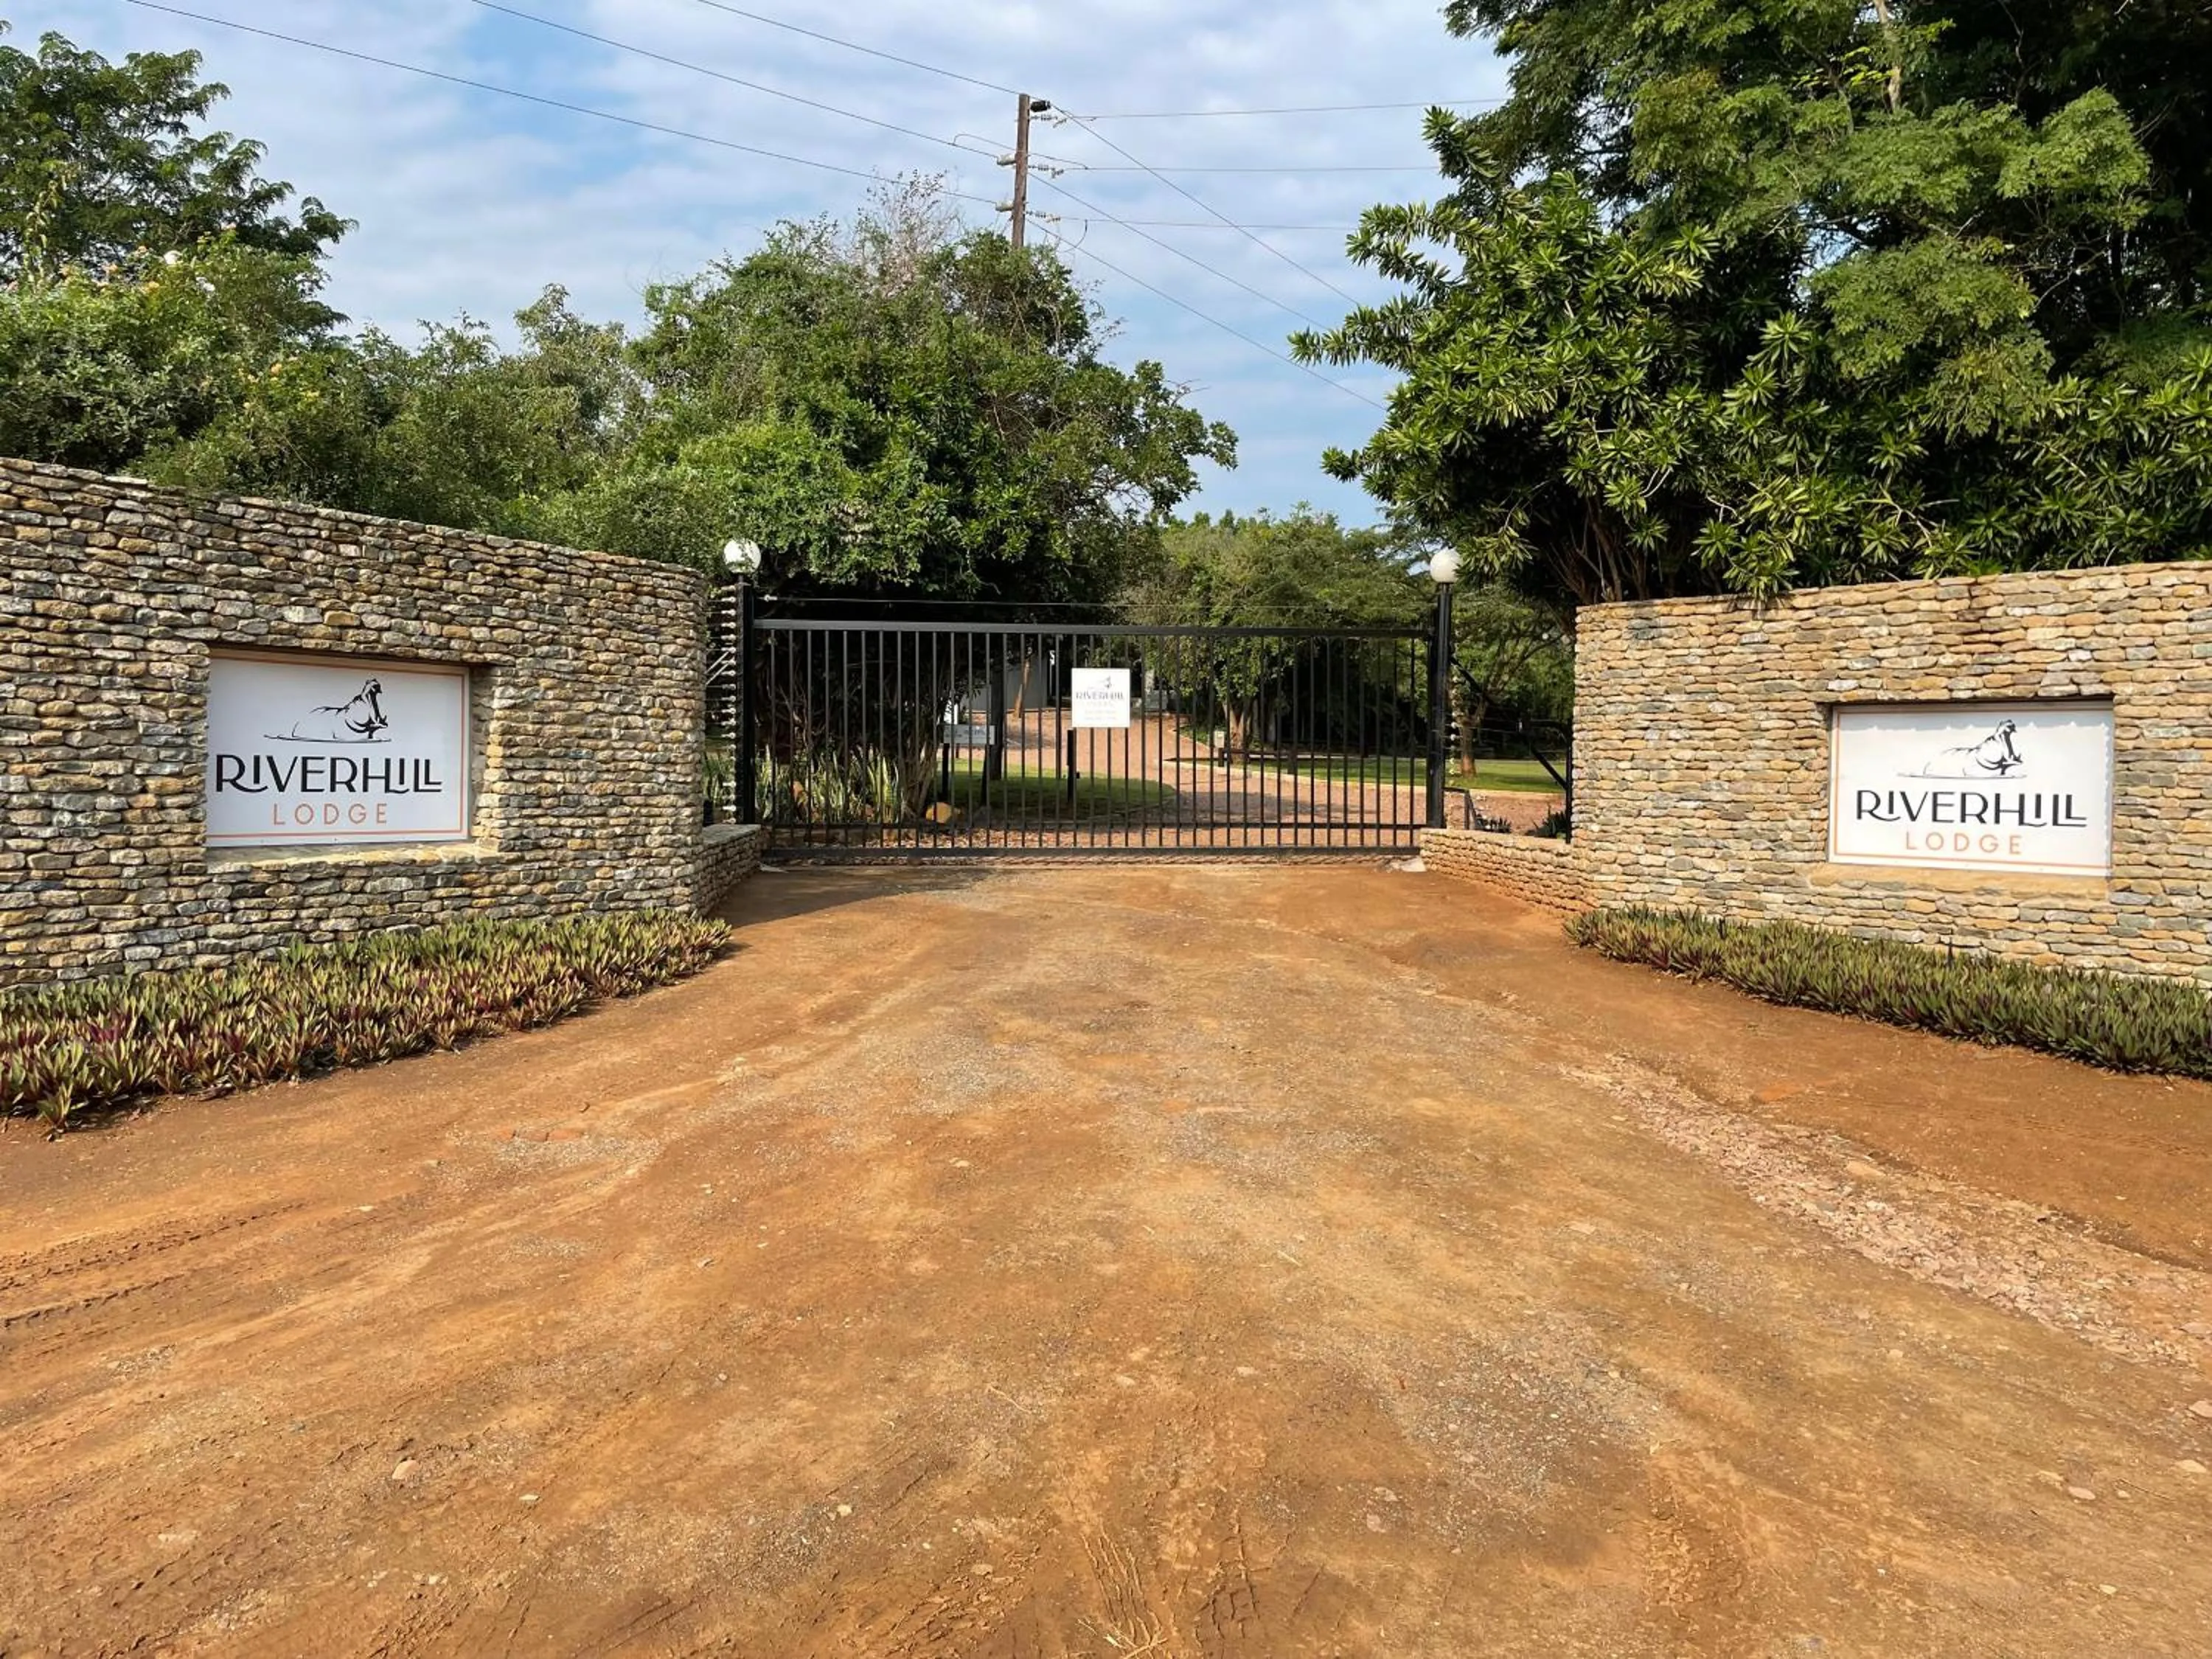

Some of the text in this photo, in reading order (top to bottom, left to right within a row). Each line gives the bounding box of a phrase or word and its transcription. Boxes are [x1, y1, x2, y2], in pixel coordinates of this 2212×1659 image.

[216, 754, 442, 794] RIVERHILL
[273, 803, 388, 825] LODGE
[1856, 790, 2087, 827] RIVERHILL
[1905, 832, 2023, 855] LODGE
